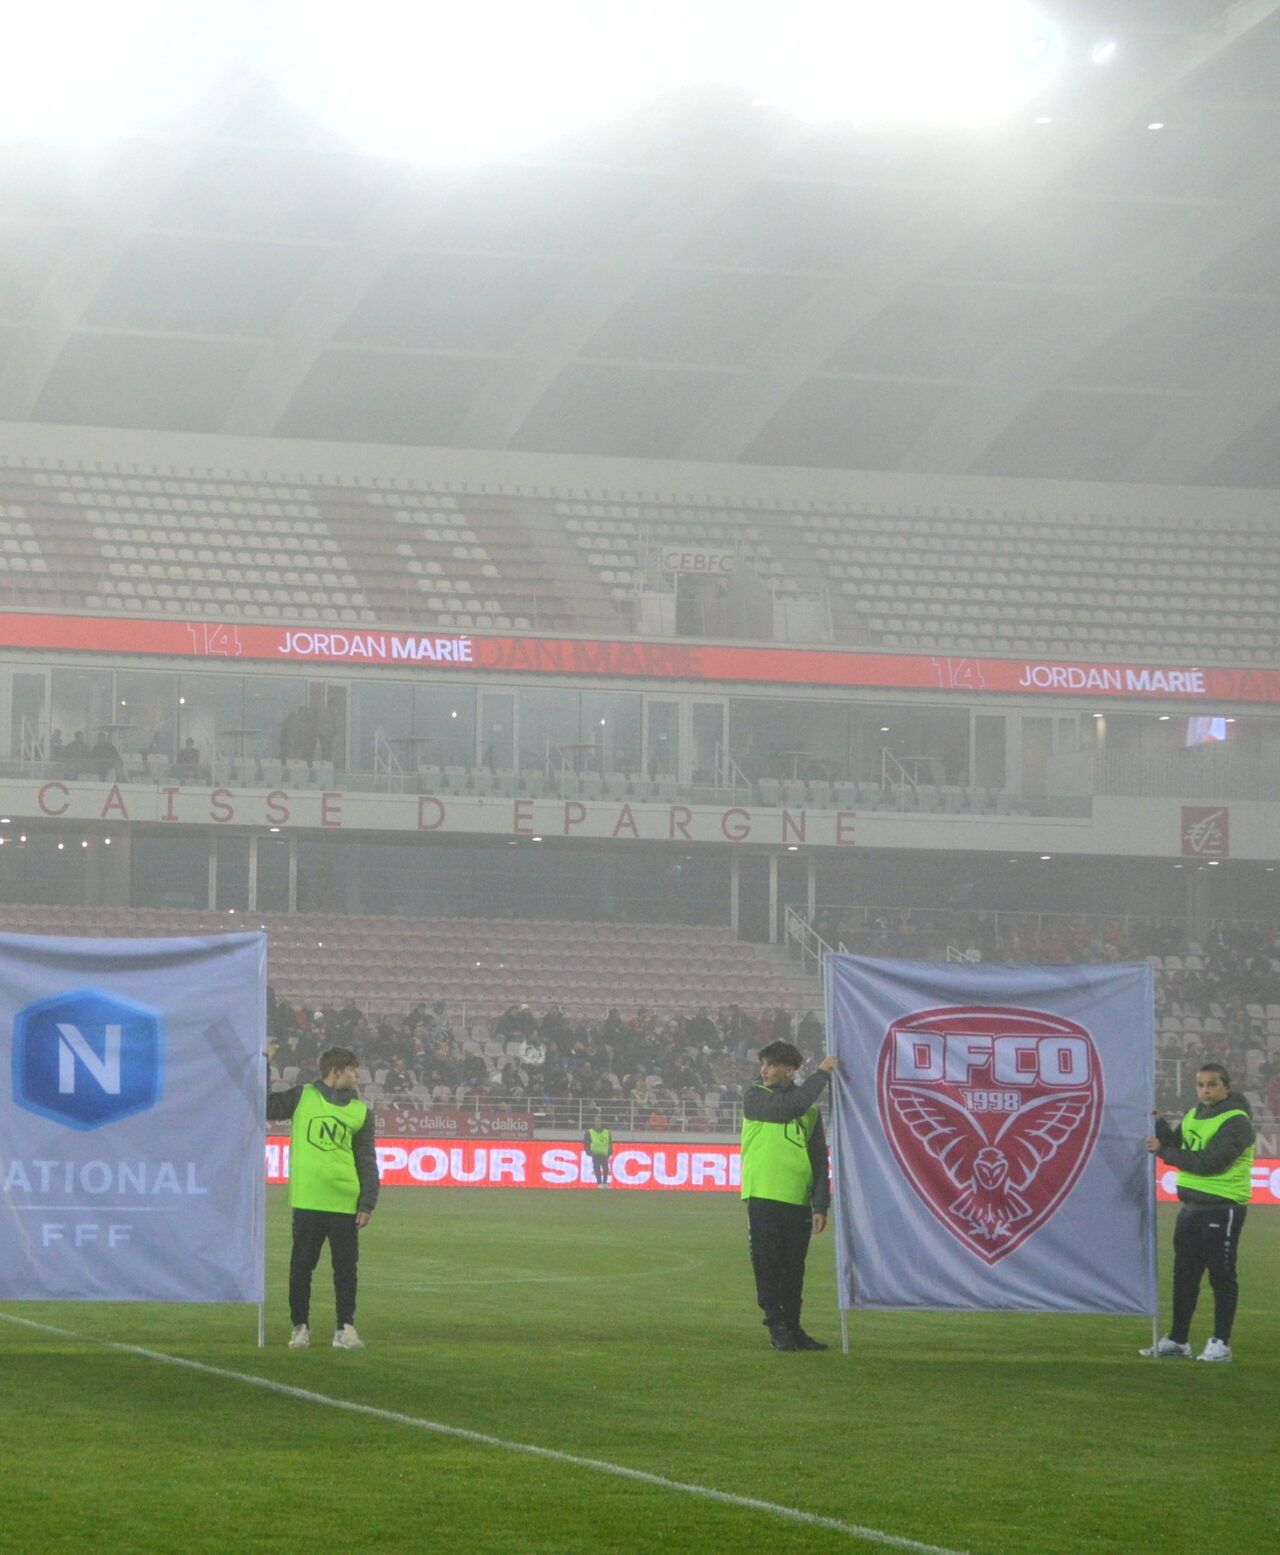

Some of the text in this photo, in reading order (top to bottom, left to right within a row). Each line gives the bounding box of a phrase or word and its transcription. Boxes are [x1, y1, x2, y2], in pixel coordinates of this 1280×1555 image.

[187, 622, 242, 657] 14
[278, 632, 473, 663] JORDAN MARIÉ
[932, 657, 984, 689] 14
[1019, 665, 1205, 694] JORDAN MARIÉ
[37, 781, 343, 827] CAISSE
[56, 1023, 121, 1095] N
[893, 1031, 1091, 1087] DFCO
[964, 1089, 1019, 1113] 1998
[319, 1120, 338, 1142] N
[420, 1115, 457, 1130] dalkia
[491, 1117, 528, 1131] dalkia
[376, 1146, 525, 1182] POUR
[41, 1222, 134, 1248] FFF
